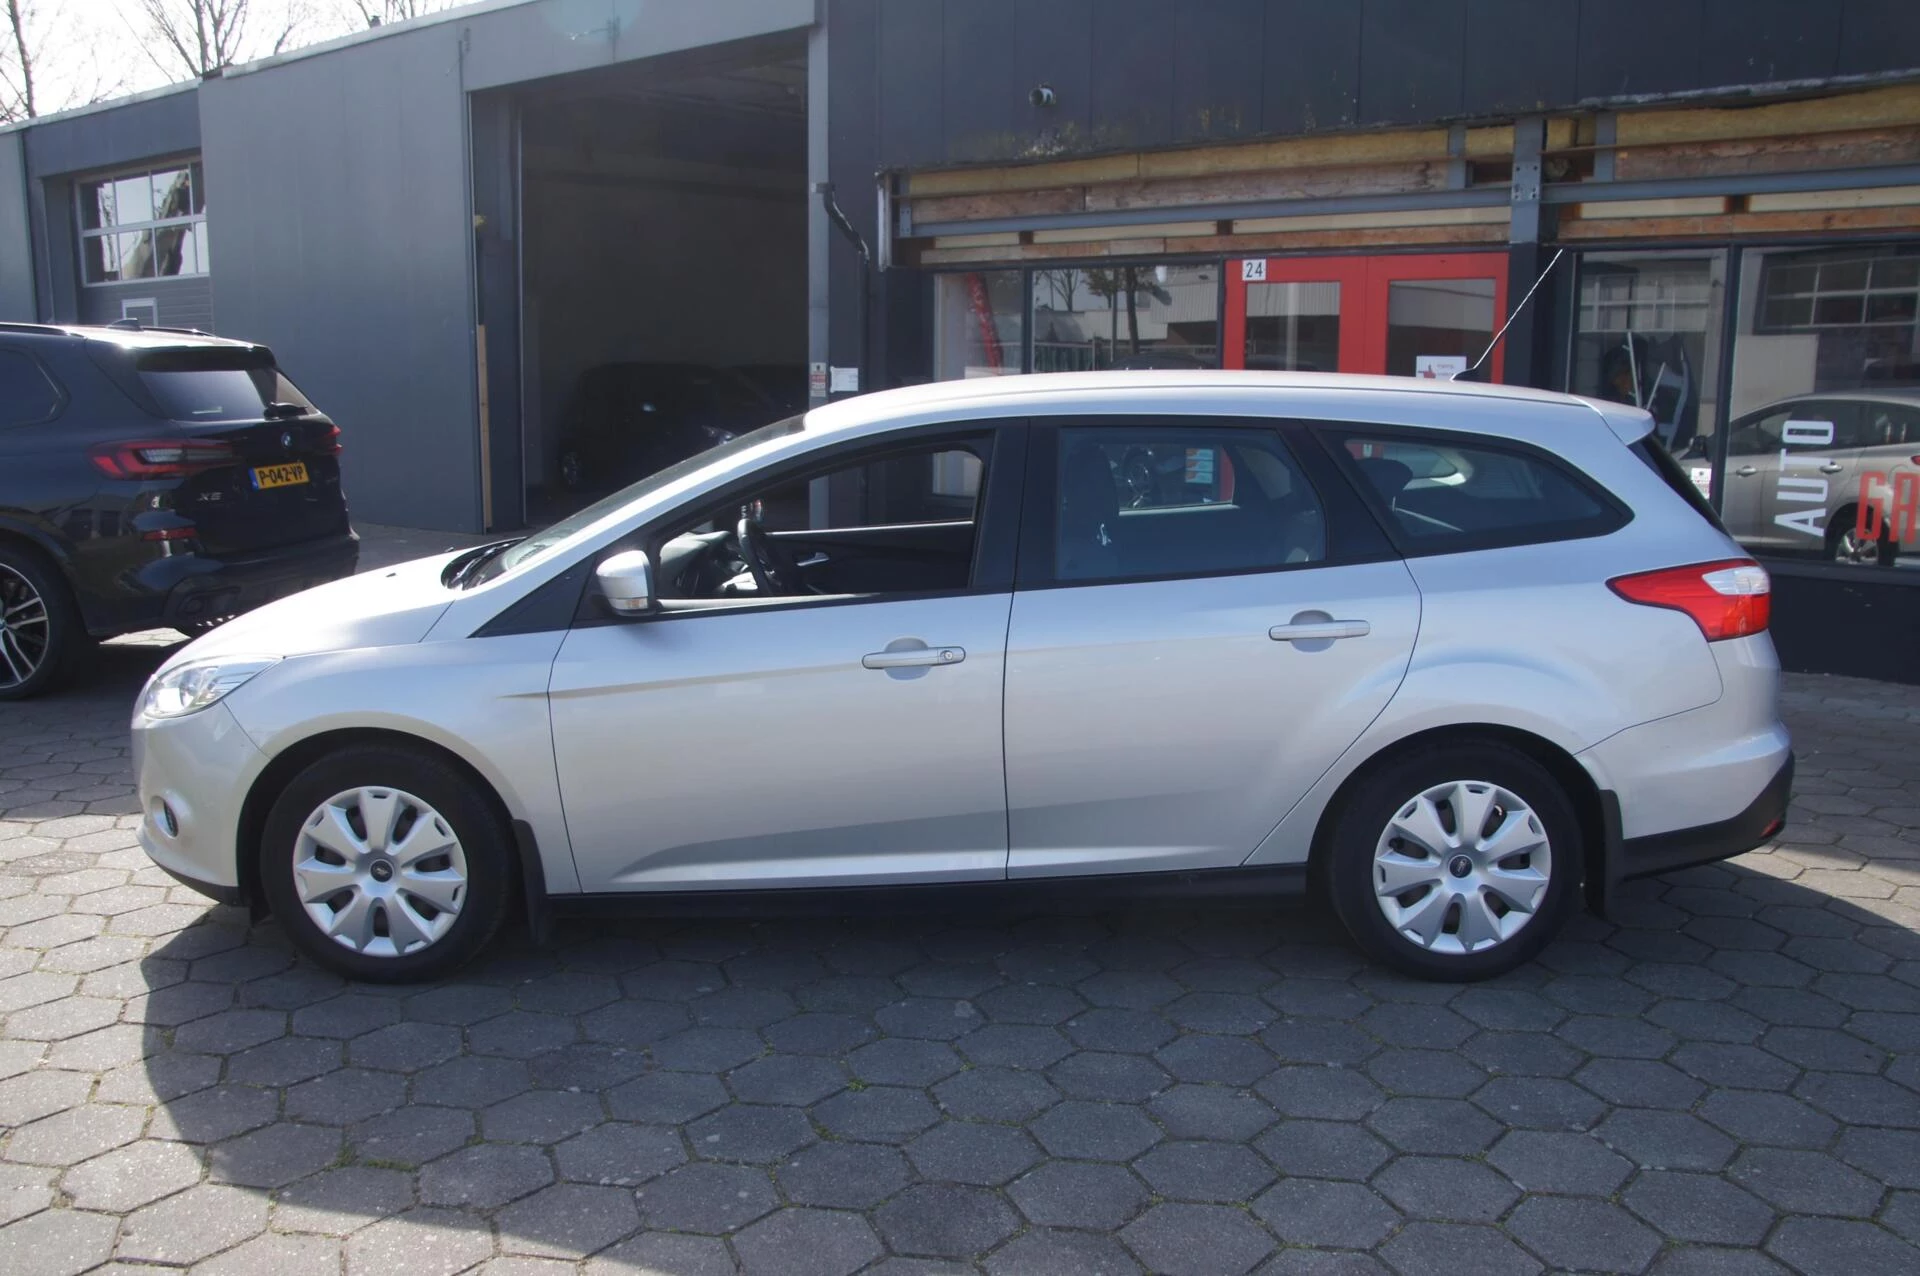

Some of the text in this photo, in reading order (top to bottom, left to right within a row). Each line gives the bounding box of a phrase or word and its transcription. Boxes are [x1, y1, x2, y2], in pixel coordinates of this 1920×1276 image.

[1246, 262, 1263, 278] 24
[258, 465, 304, 486] P-042-VP
[1774, 420, 1834, 537] AUTO
